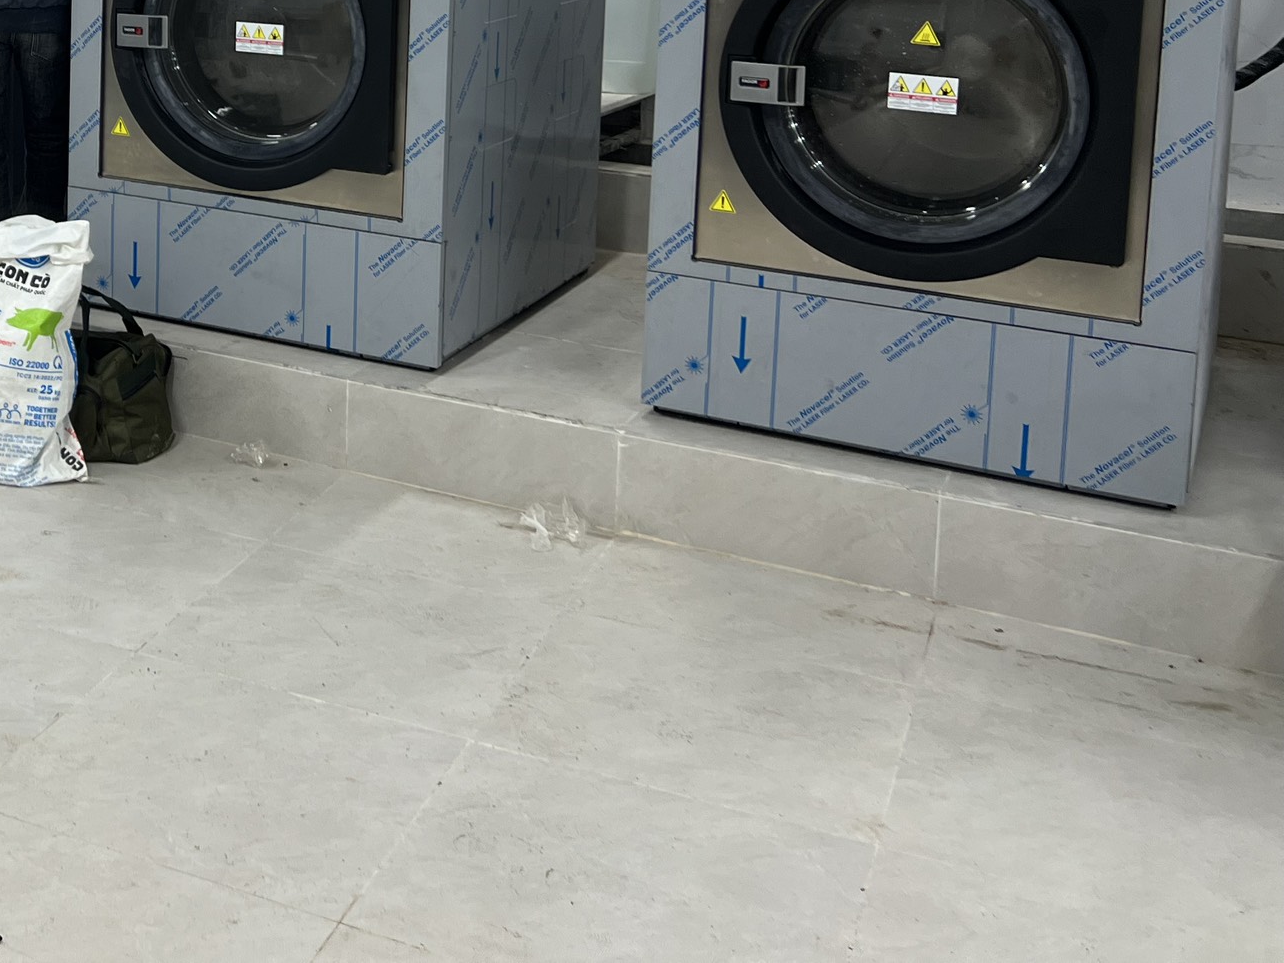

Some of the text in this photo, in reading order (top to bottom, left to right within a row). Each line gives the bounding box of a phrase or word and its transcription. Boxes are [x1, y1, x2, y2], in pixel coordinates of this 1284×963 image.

[425, 13, 448, 34] Solution
[1169, 26, 1188, 41] Fiber
[1192, 5, 1217, 24] LASER
[428, 27, 444, 43] LASER
[681, 108, 700, 123] LASER
[422, 119, 444, 139] Solution
[1179, 120, 1213, 144] Solution
[424, 133, 440, 148] LASER
[1160, 157, 1178, 171] Fiber
[1182, 137, 1206, 155] LASER
[169, 228, 178, 237] The
[179, 224, 192, 238] LASER
[262, 227, 276, 241] LASER
[277, 228, 287, 237] The
[675, 222, 694, 237] LASER
[237, 251, 250, 264] LASER
[379, 258, 395, 272] LASER
[394, 248, 406, 260] Fiber
[1169, 250, 1203, 273] Solution
[233, 259, 253, 277] Solution
[368, 262, 379, 271] The
[30, 273, 51, 288] CÒ
[1150, 285, 1168, 299] Fiber
[1172, 266, 1196, 284] LASER
[200, 285, 219, 303] Solution
[202, 297, 214, 311] LASER
[793, 302, 807, 312] The
[799, 311, 809, 319] for
[808, 297, 828, 313] LASER
[916, 317, 932, 330] Fiber
[403, 323, 425, 342] Solution
[892, 332, 913, 347] LASER
[405, 336, 421, 351] LASER
[886, 341, 916, 362] Solution
[1089, 349, 1105, 359] The
[1095, 359, 1107, 368] for
[1106, 344, 1129, 361] LASER
[9, 357, 50, 370] ISO 22000
[653, 374, 671, 389] LASER
[672, 376, 685, 385] The
[40, 384, 53, 394] 25
[787, 417, 801, 427] The
[836, 372, 864, 393] Solution
[27, 405, 57, 413] TOGETHER
[801, 413, 821, 429] LASER
[819, 403, 835, 416] Fiber
[838, 387, 858, 402] LASER
[908, 417, 954, 449] for LASER Fiber
[946, 425, 961, 435] The
[1079, 473, 1096, 483] The
[1137, 425, 1170, 447] Solution
[1096, 469, 1120, 485] LASER
[1118, 458, 1136, 472] Fiber
[1140, 441, 1164, 458] LASER
